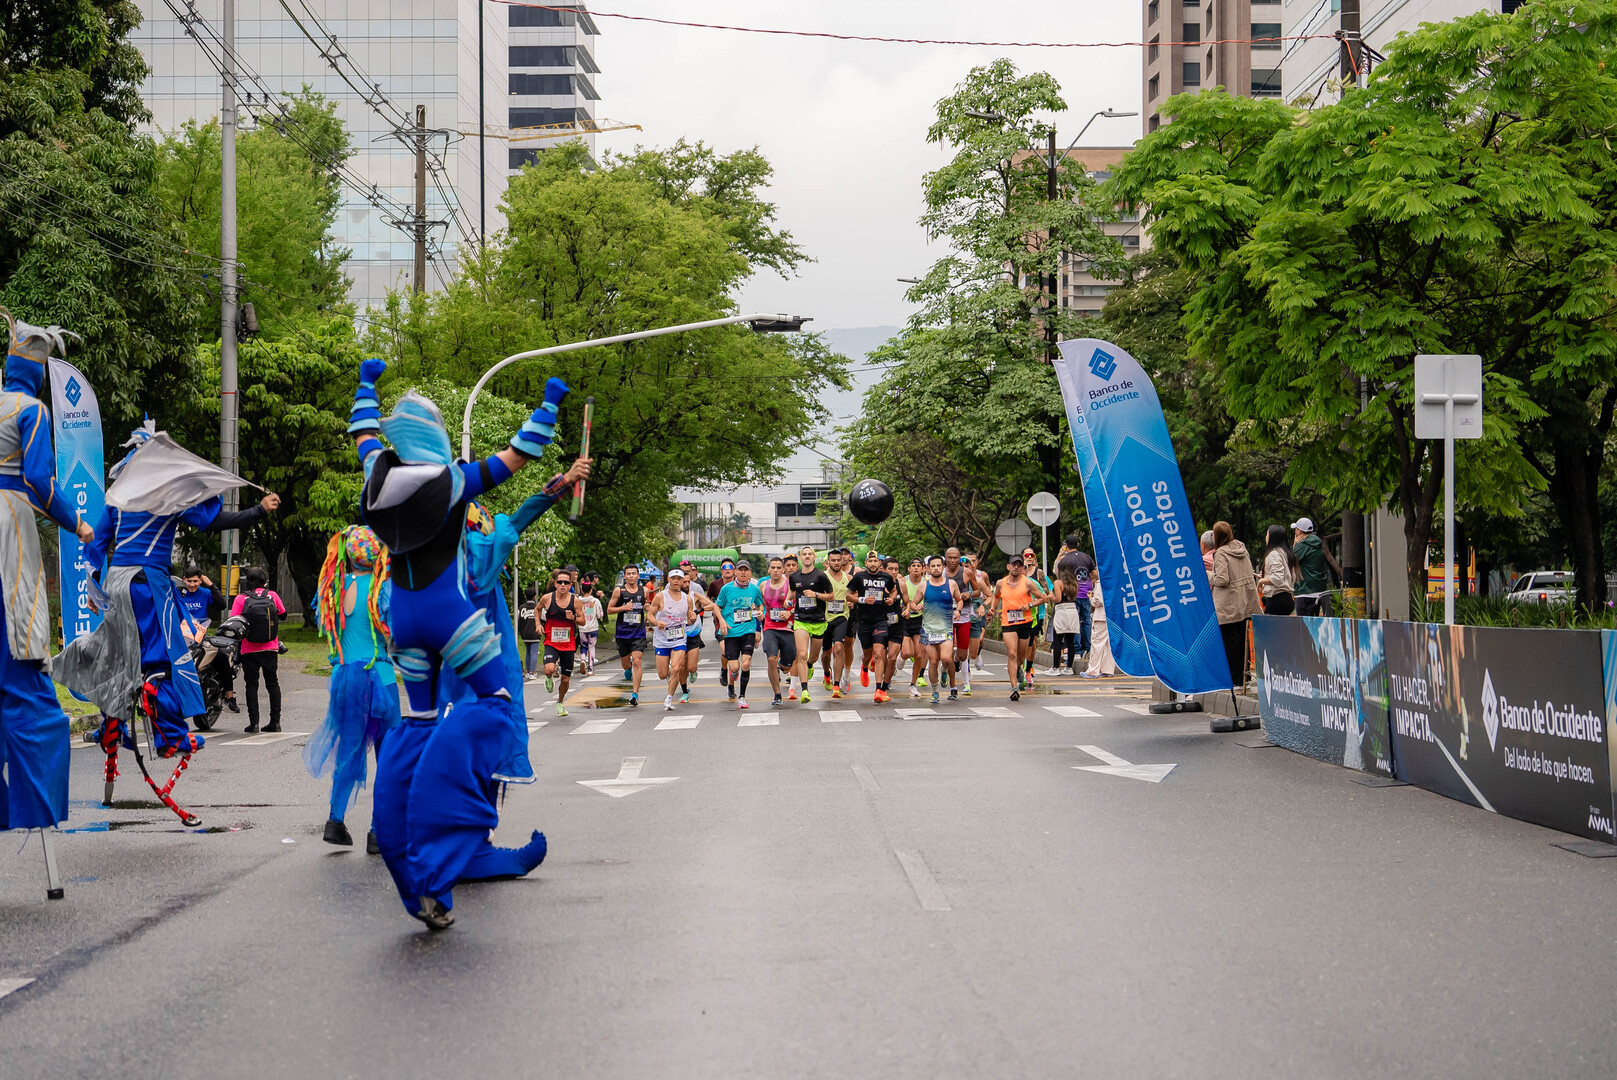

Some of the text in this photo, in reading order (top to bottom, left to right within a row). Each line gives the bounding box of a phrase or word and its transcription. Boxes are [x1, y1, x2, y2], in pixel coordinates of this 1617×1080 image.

[1088, 380, 1134, 400] Banco de
[1090, 391, 1140, 411] Occidente
[81, 409, 89, 418] de
[860, 487, 876, 500] 2:55
[1122, 484, 1172, 625] Unidos por
[1151, 480, 1198, 606] tus metas
[863, 579, 886, 588] PACER
[75, 579, 91, 636] Eres
[1271, 668, 1284, 692] Banco
[1289, 672, 1312, 698] Occidente
[1317, 673, 1327, 697] TU
[1391, 674, 1431, 711] TU HACER,
[1395, 707, 1435, 743] IMPACTA.
[1500, 696, 1531, 732] Banco
[1532, 700, 1546, 734] de
[1545, 701, 1602, 743] Occidente
[1504, 747, 1595, 784] Del lado de los que hacen.
[1588, 815, 1613, 835] AVAL
